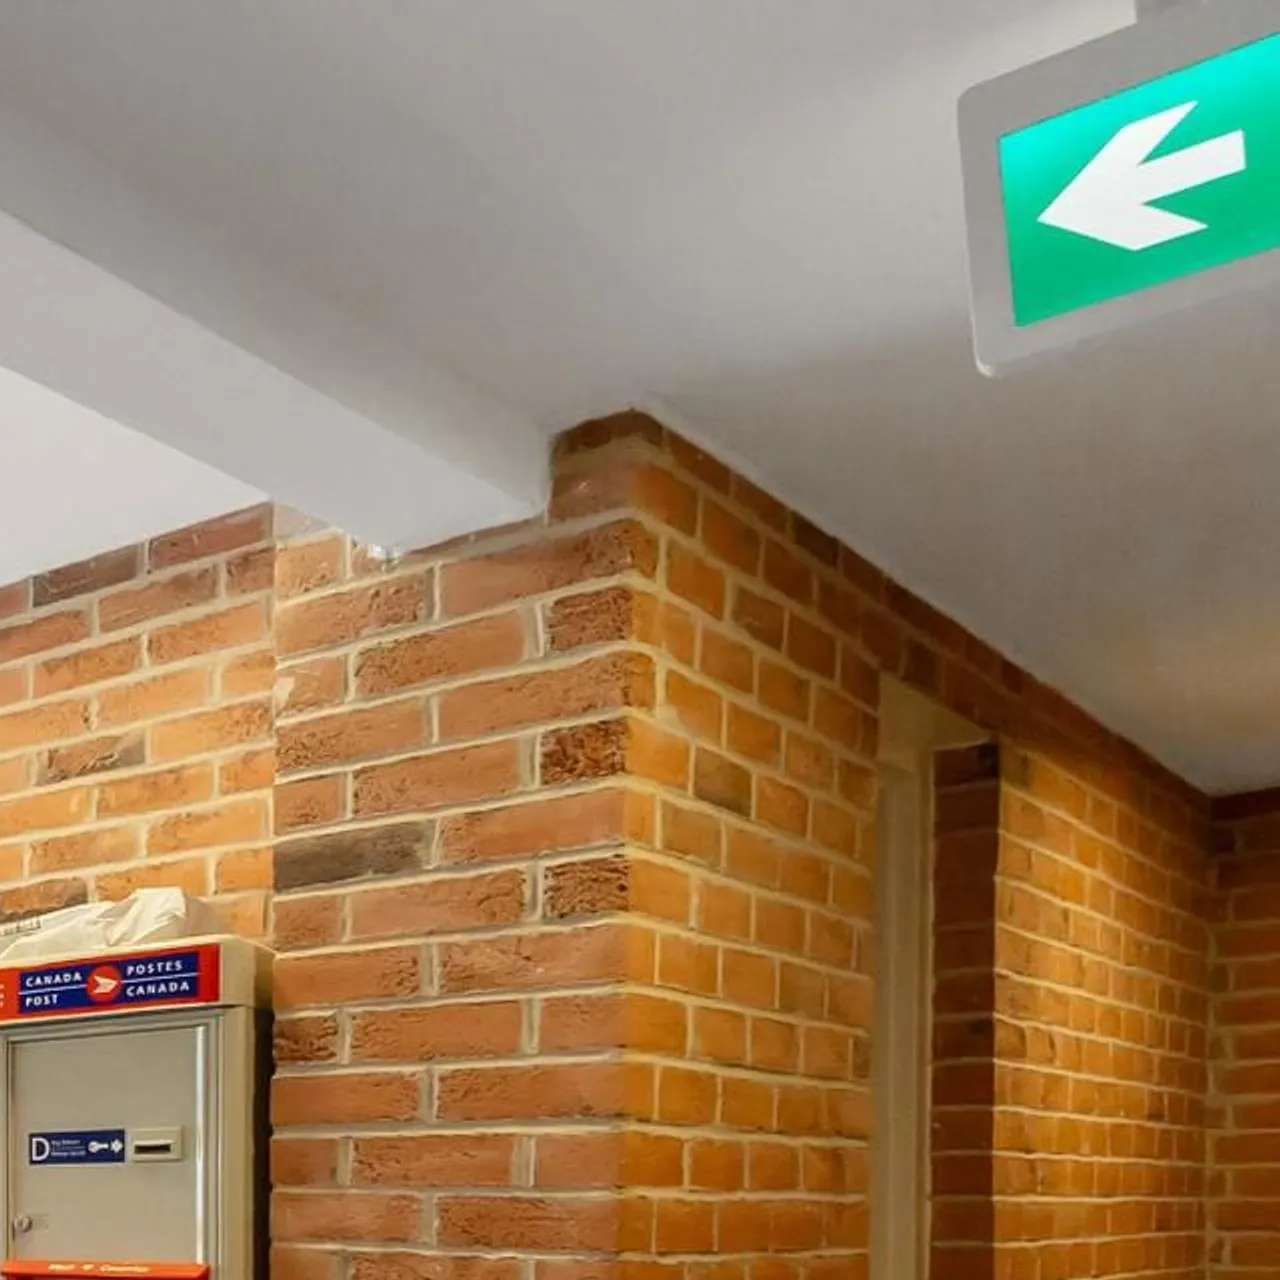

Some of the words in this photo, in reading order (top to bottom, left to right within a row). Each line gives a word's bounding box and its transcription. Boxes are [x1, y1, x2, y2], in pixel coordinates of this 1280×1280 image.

[126, 959, 183, 976] POSTES
[25, 971, 83, 988] CANADA
[125, 981, 190, 998] CANADA
[25, 994, 59, 1008] POST
[32, 1137, 50, 1161] D
